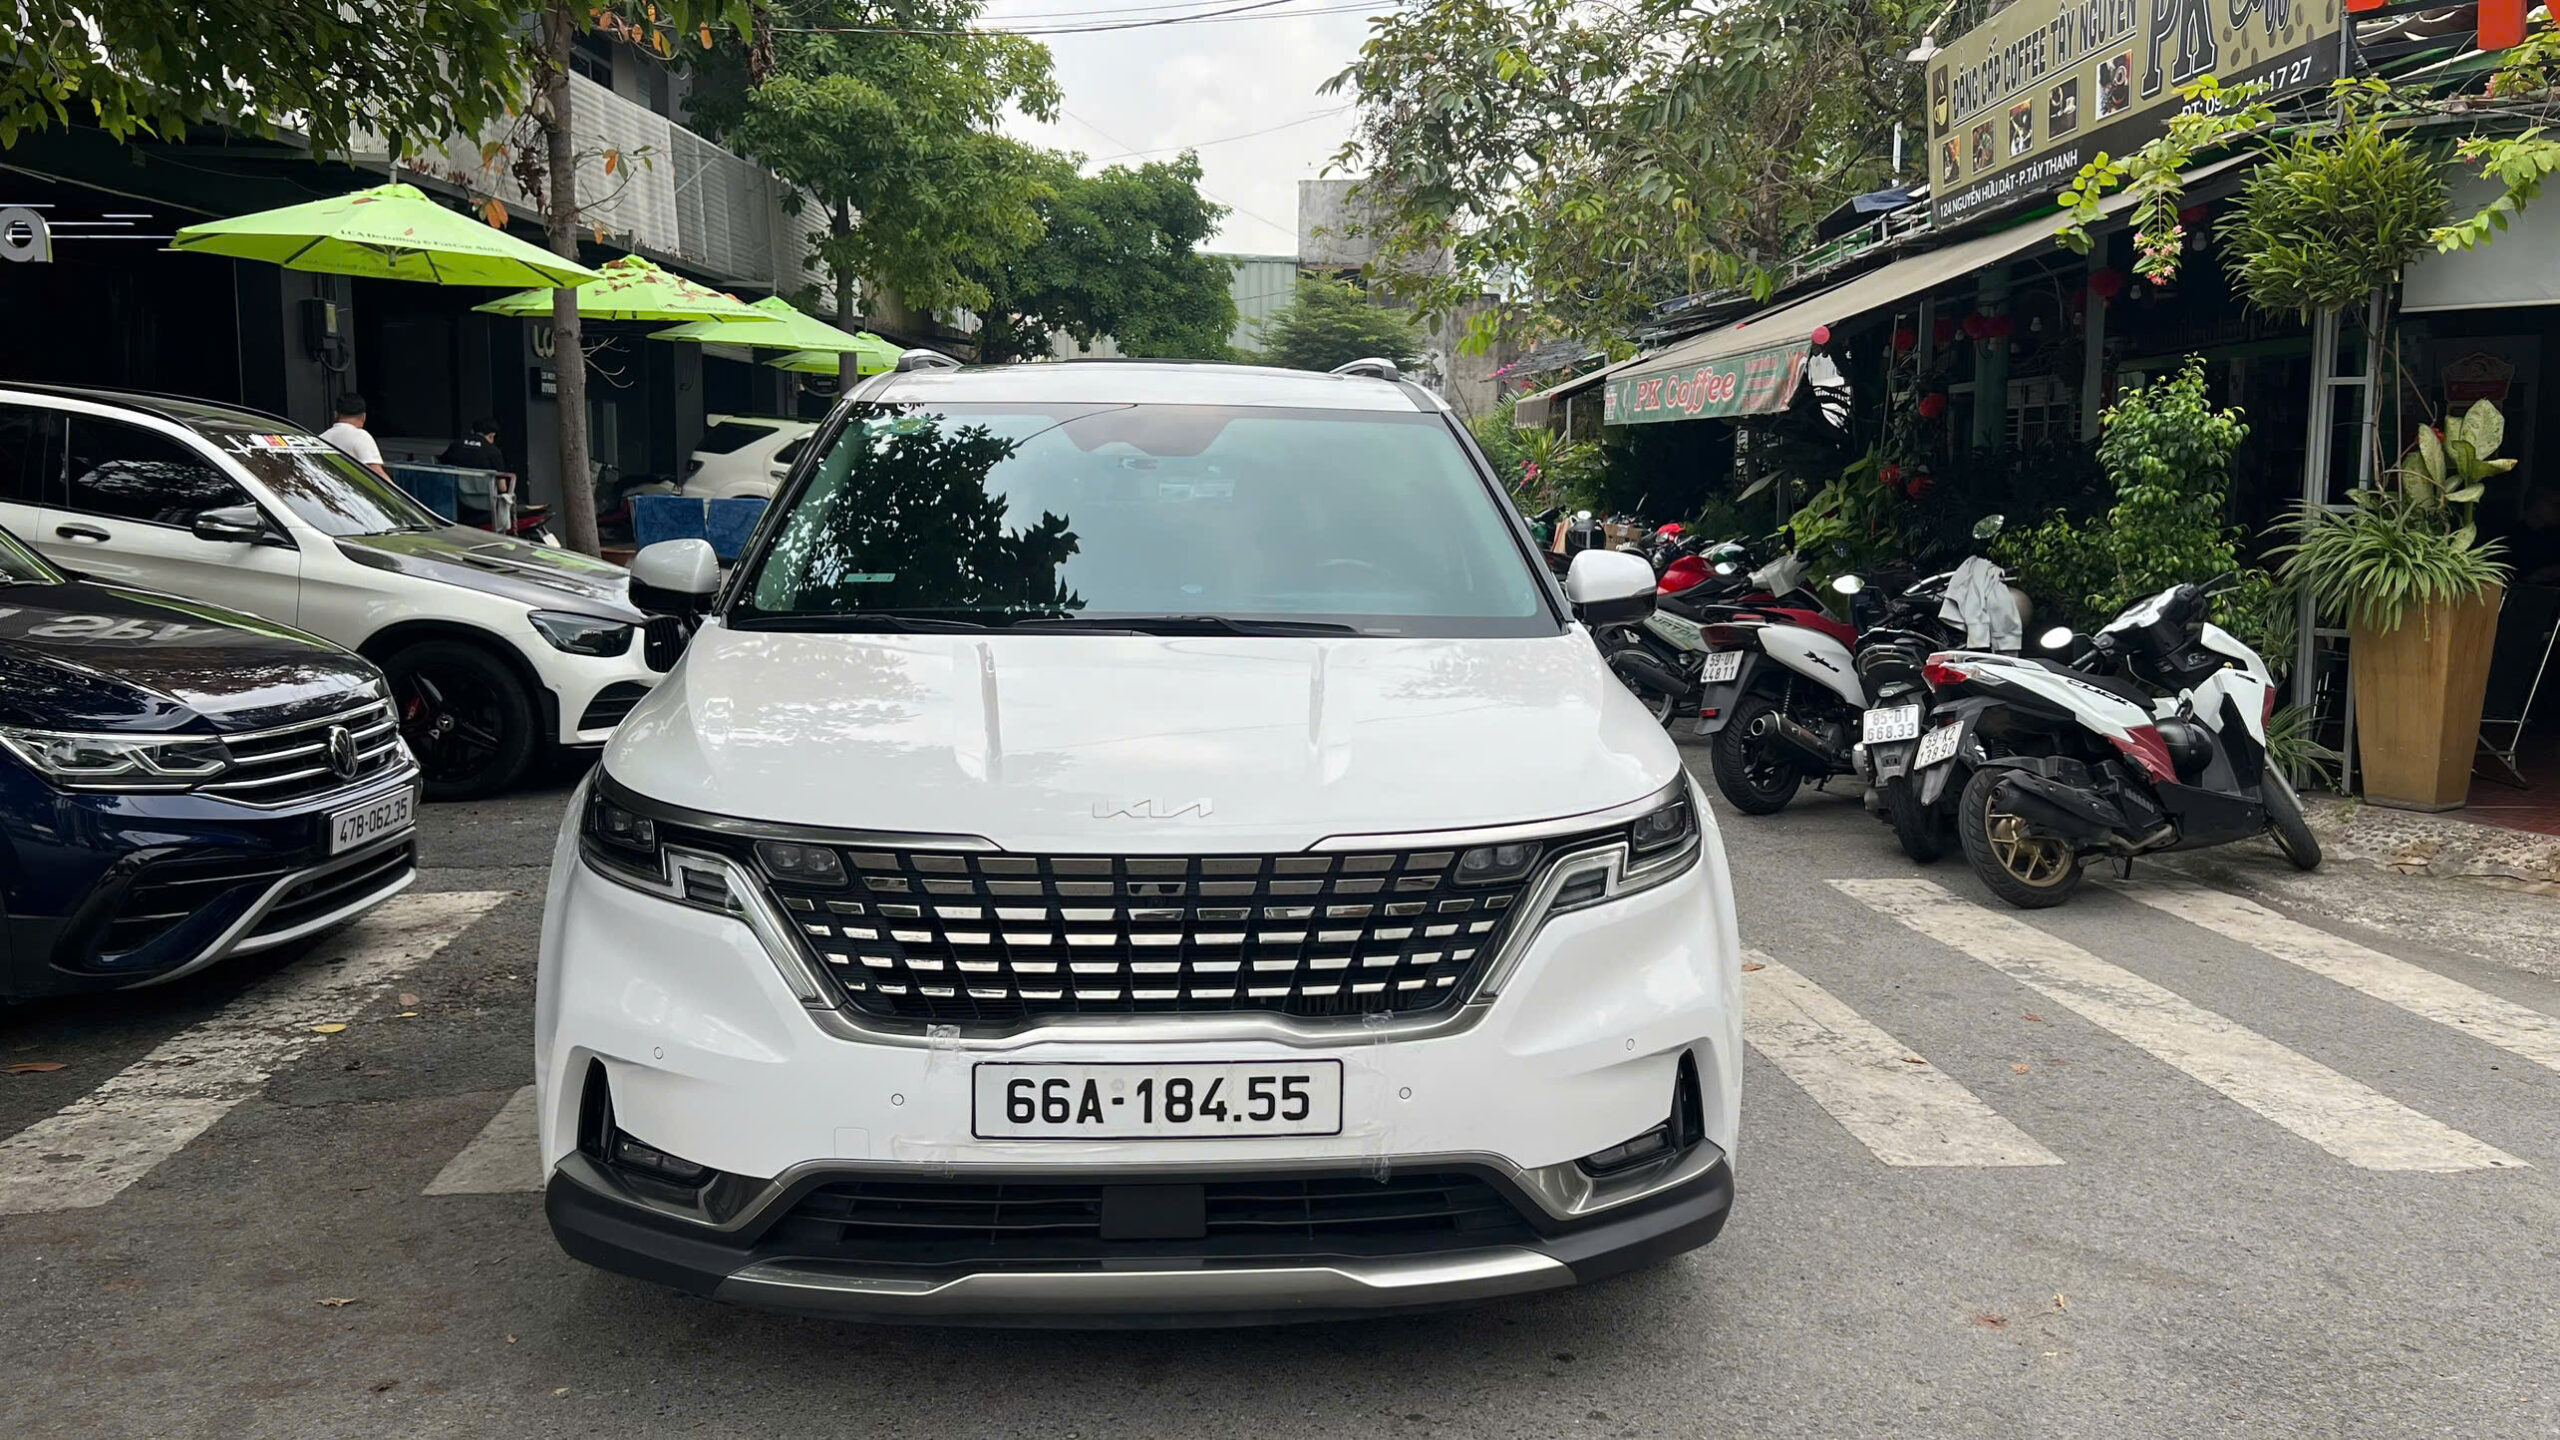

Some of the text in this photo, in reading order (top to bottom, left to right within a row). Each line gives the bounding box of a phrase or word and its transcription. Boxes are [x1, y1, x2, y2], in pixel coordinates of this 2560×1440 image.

[1981, 35, 2001, 106] CẤP
[2004, 26, 2047, 93] COFFEE
[2049, 0, 2076, 68] TÂY
[2290, 56, 2312, 84] 27
[1940, 202, 1952, 218] 124
[1634, 378, 1663, 413] PK
[1665, 365, 1737, 415] Coffee
[1867, 722, 1915, 742] 668.33
[338, 797, 408, 845] 47B-062.35
[1006, 1075, 1310, 1124] 66A-184.55
